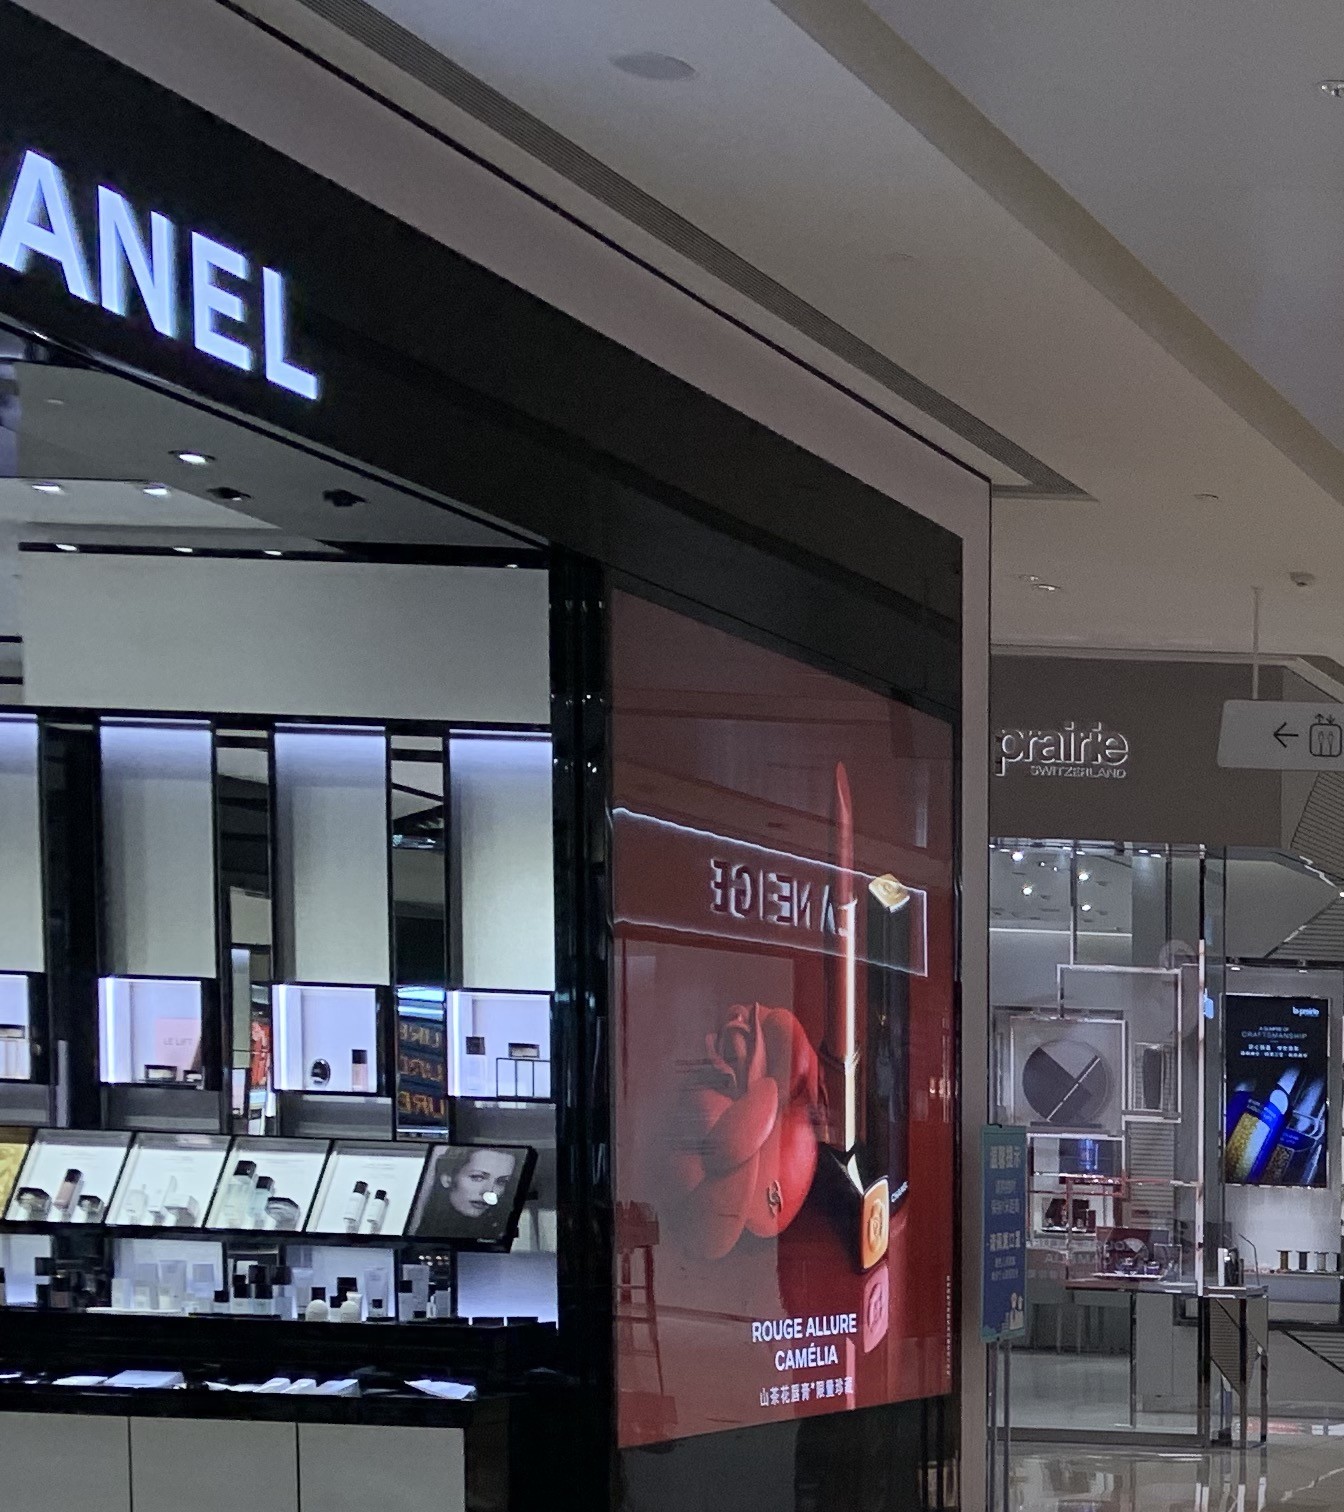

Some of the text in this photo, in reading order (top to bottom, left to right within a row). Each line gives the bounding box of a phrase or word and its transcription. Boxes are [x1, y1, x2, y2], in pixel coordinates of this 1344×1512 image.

[0, 149, 318, 401] ANEL
[996, 721, 1129, 777] prairie
[1030, 765, 1127, 779] SWITZERLAND
[751, 1313, 857, 1343] ROUGE ALLURE
[774, 1342, 838, 1371] CAMÉLIA
